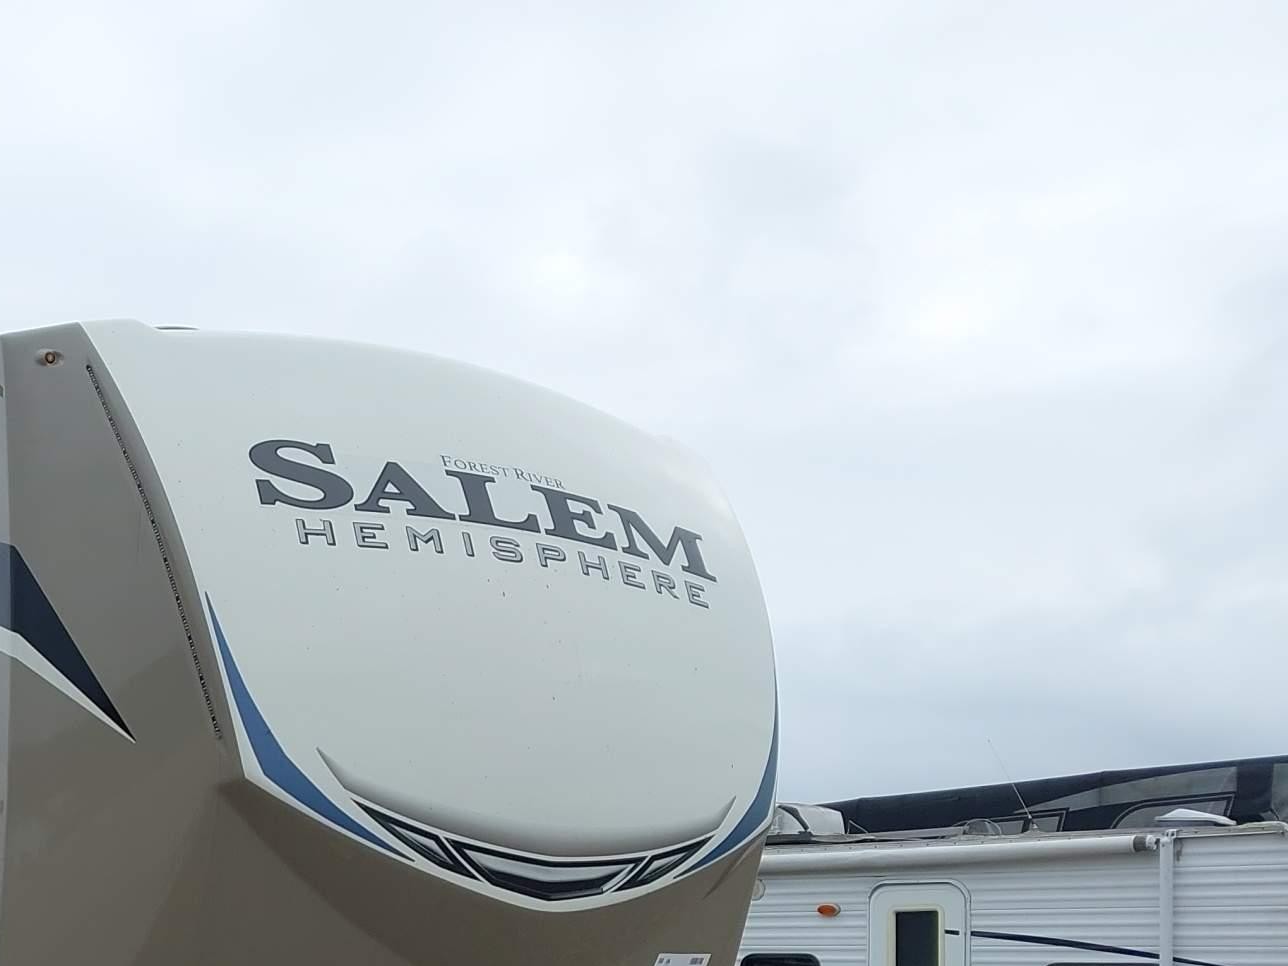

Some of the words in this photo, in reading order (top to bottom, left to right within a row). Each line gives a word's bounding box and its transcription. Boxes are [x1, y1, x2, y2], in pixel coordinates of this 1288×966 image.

[248, 438, 717, 582] SALEM
[439, 454, 510, 478] FOREST
[512, 466, 566, 490] RIVER
[294, 517, 711, 610] HEMISPHERE
